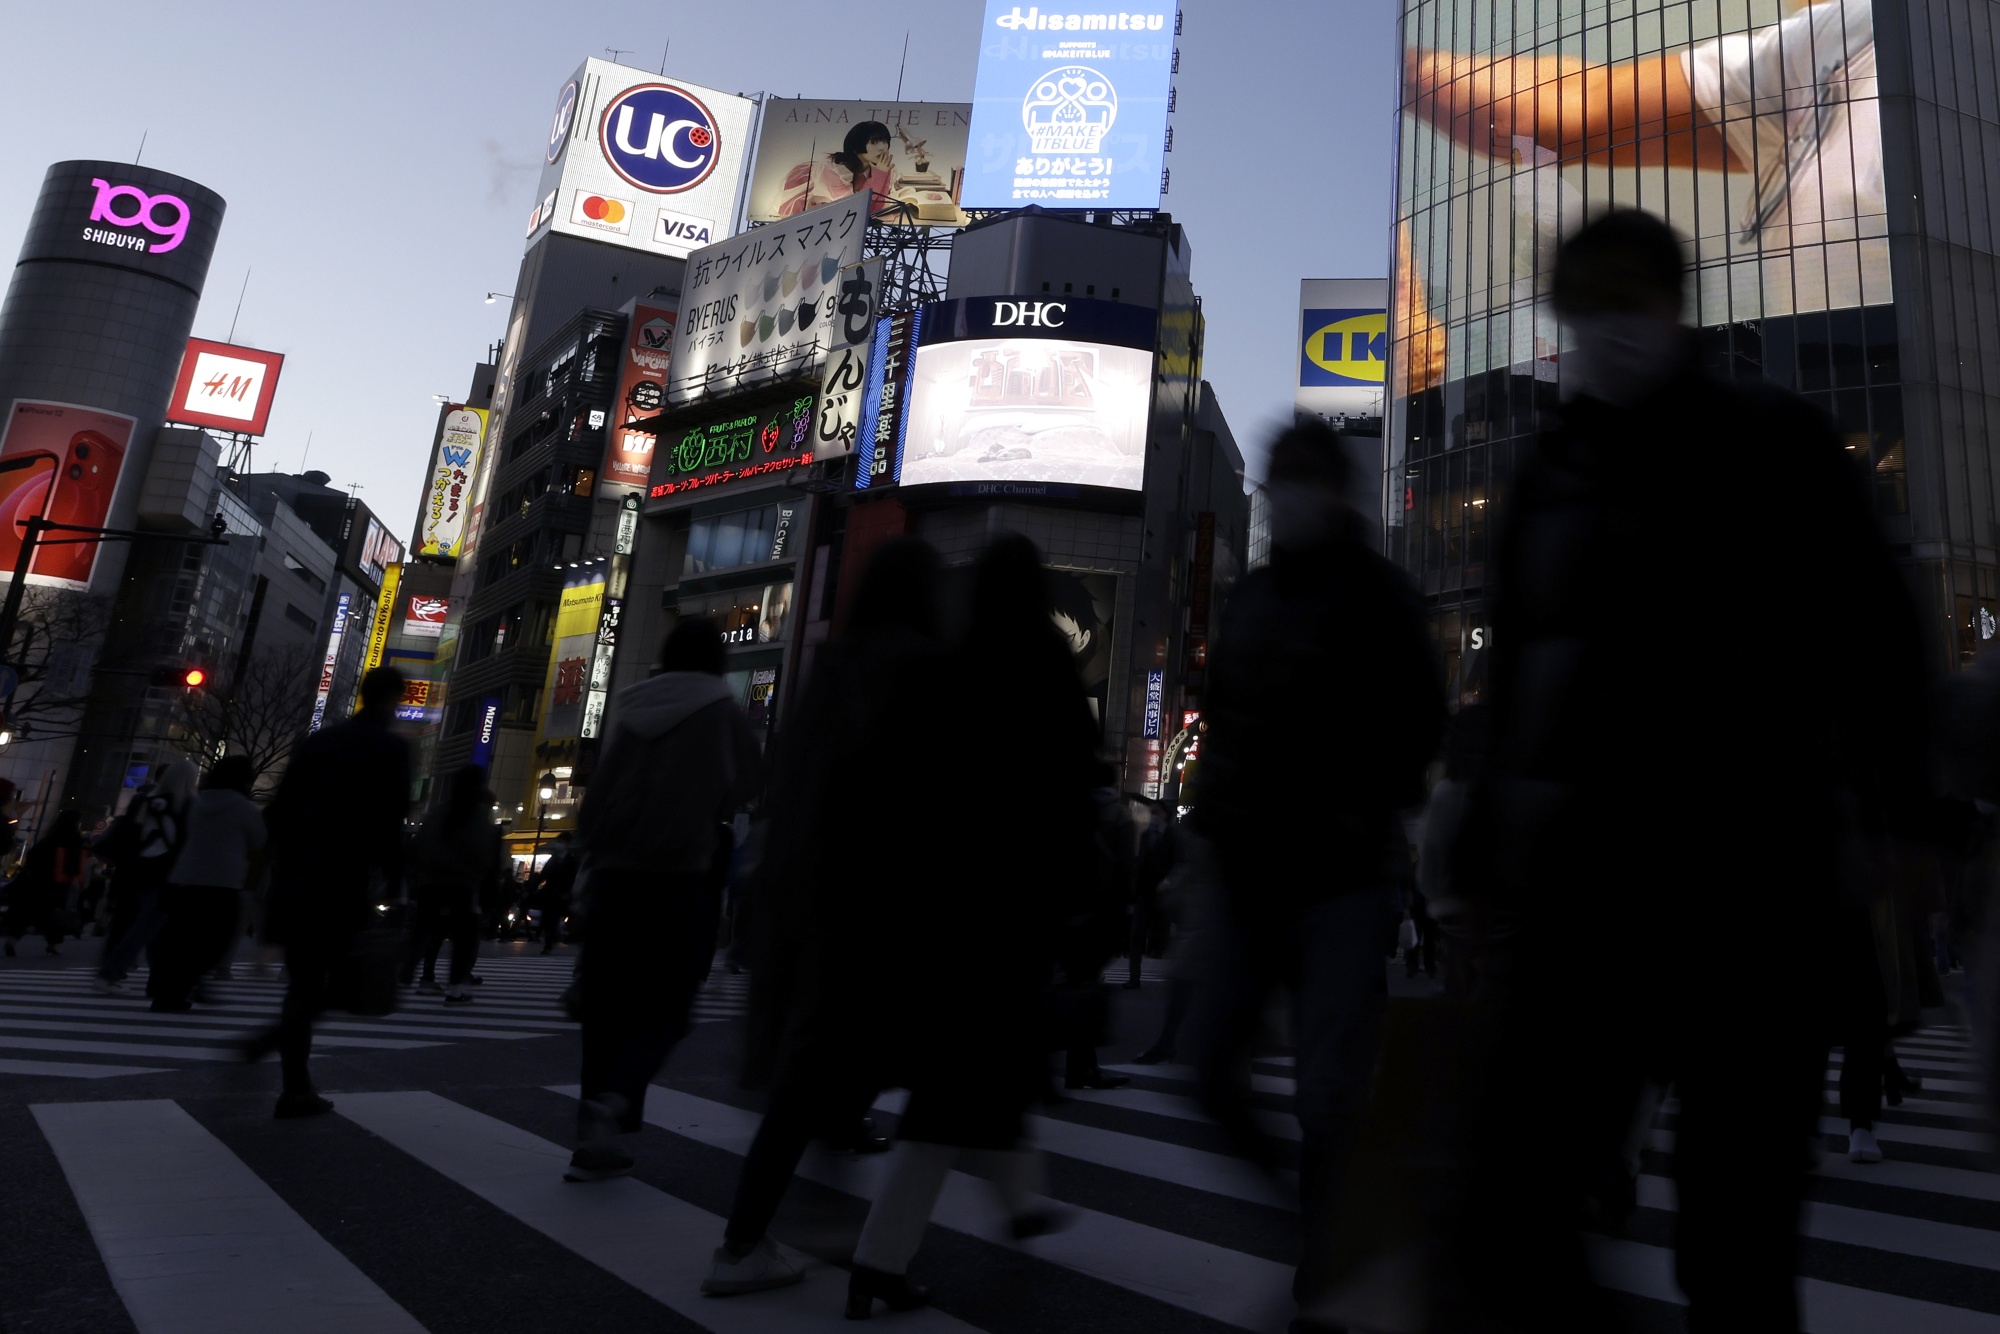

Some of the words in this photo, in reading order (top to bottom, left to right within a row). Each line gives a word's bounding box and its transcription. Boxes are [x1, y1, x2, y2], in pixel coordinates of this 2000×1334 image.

[996, 7, 1163, 31] Hisamitsu
[1043, 49, 1110, 59] #MAKEITBLUE
[1059, 41, 1097, 49] SUPPORTS
[868, 107, 923, 127] THE
[1036, 125, 1099, 138] #MAKE
[1036, 137, 1096, 150] ITBLUE
[89, 178, 191, 254] 109
[580, 218, 621, 232] mastercard
[82, 226, 146, 252] SHIBUYA
[661, 218, 710, 244] VISA
[797, 209, 858, 251] マスク
[686, 293, 739, 337] BYERUS
[825, 295, 836, 318] 9
[992, 302, 1066, 327] DHC
[687, 330, 725, 354] バイラス
[820, 266, 872, 452] もんじゃ
[200, 372, 252, 403] H&M
[869, 317, 905, 476] 三千里薬品
[704, 428, 755, 467] 西村
[977, 484, 1001, 495] DHC
[1003, 484, 1047, 496] Channel
[563, 594, 594, 608] Matsumoto
[333, 606, 348, 633] LABI
[367, 625, 385, 673] atsumoto
[380, 589, 393, 625] KiYoshi
[320, 663, 335, 693] LABI
[400, 680, 429, 705] 薬
[481, 705, 497, 745] MIZUHO
